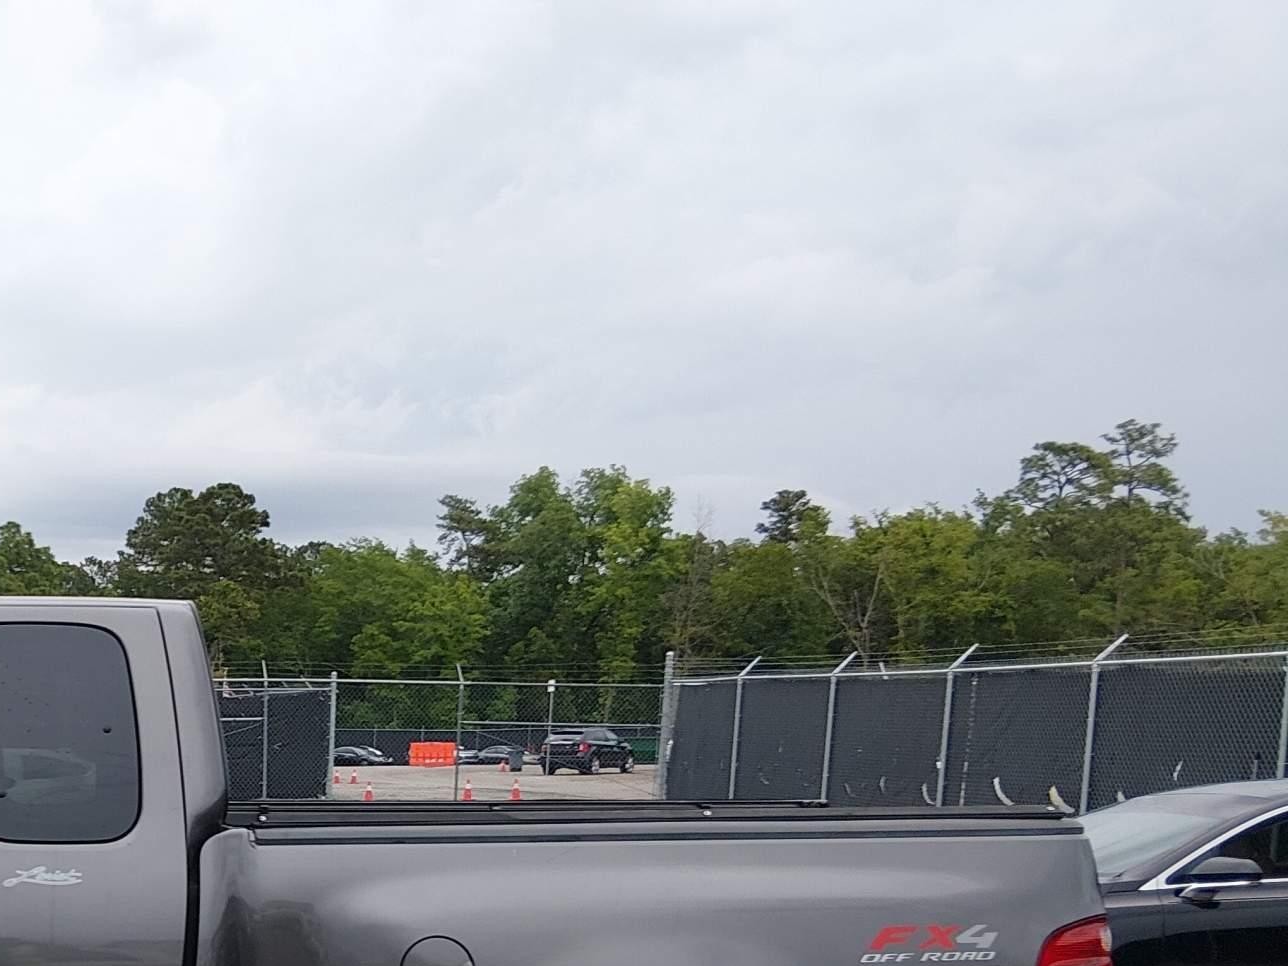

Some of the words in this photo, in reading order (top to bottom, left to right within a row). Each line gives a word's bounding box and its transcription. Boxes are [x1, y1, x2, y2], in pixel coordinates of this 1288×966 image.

[869, 924, 999, 950] FX4
[860, 953, 915, 963] OFF
[920, 951, 996, 962] ROAD
